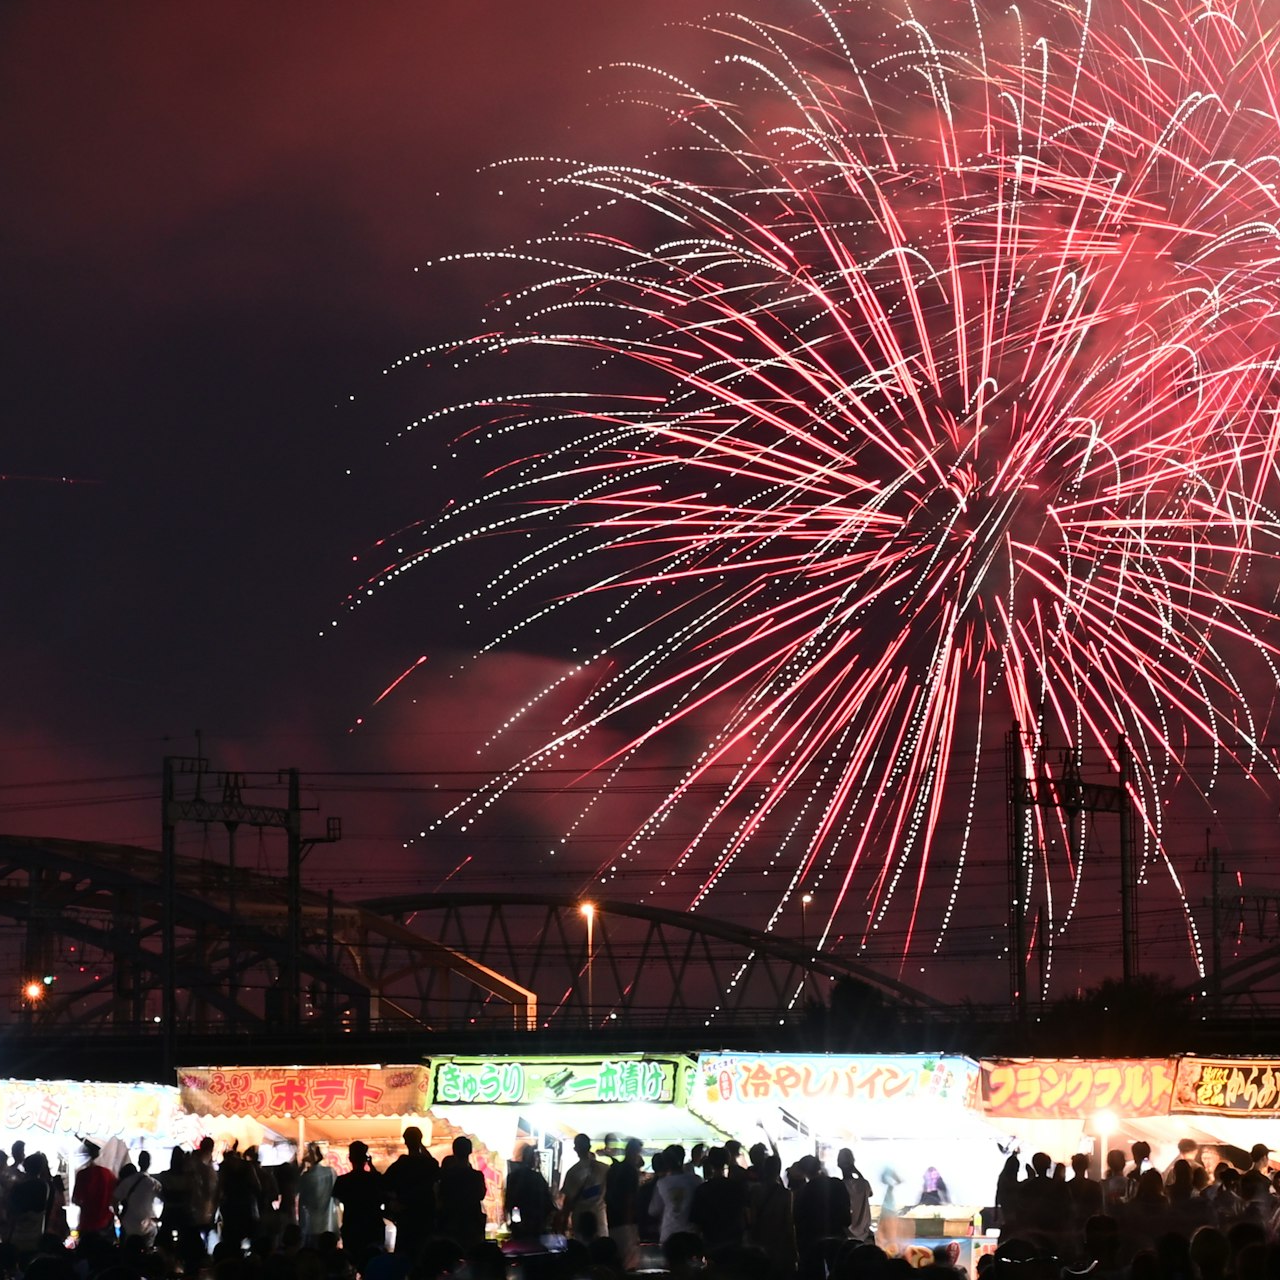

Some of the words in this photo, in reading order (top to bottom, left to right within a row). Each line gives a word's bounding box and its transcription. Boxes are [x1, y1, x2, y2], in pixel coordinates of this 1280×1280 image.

[208, 1072, 251, 1094] ふり
[271, 1077, 382, 1112] ポテト
[441, 1063, 524, 1102] きゅうり
[570, 1061, 667, 1101] 一本漬け
[739, 1063, 912, 1099] 冷やしパイン
[989, 1065, 1174, 1108] フランクフルト
[224, 1090, 267, 1112] ふり
